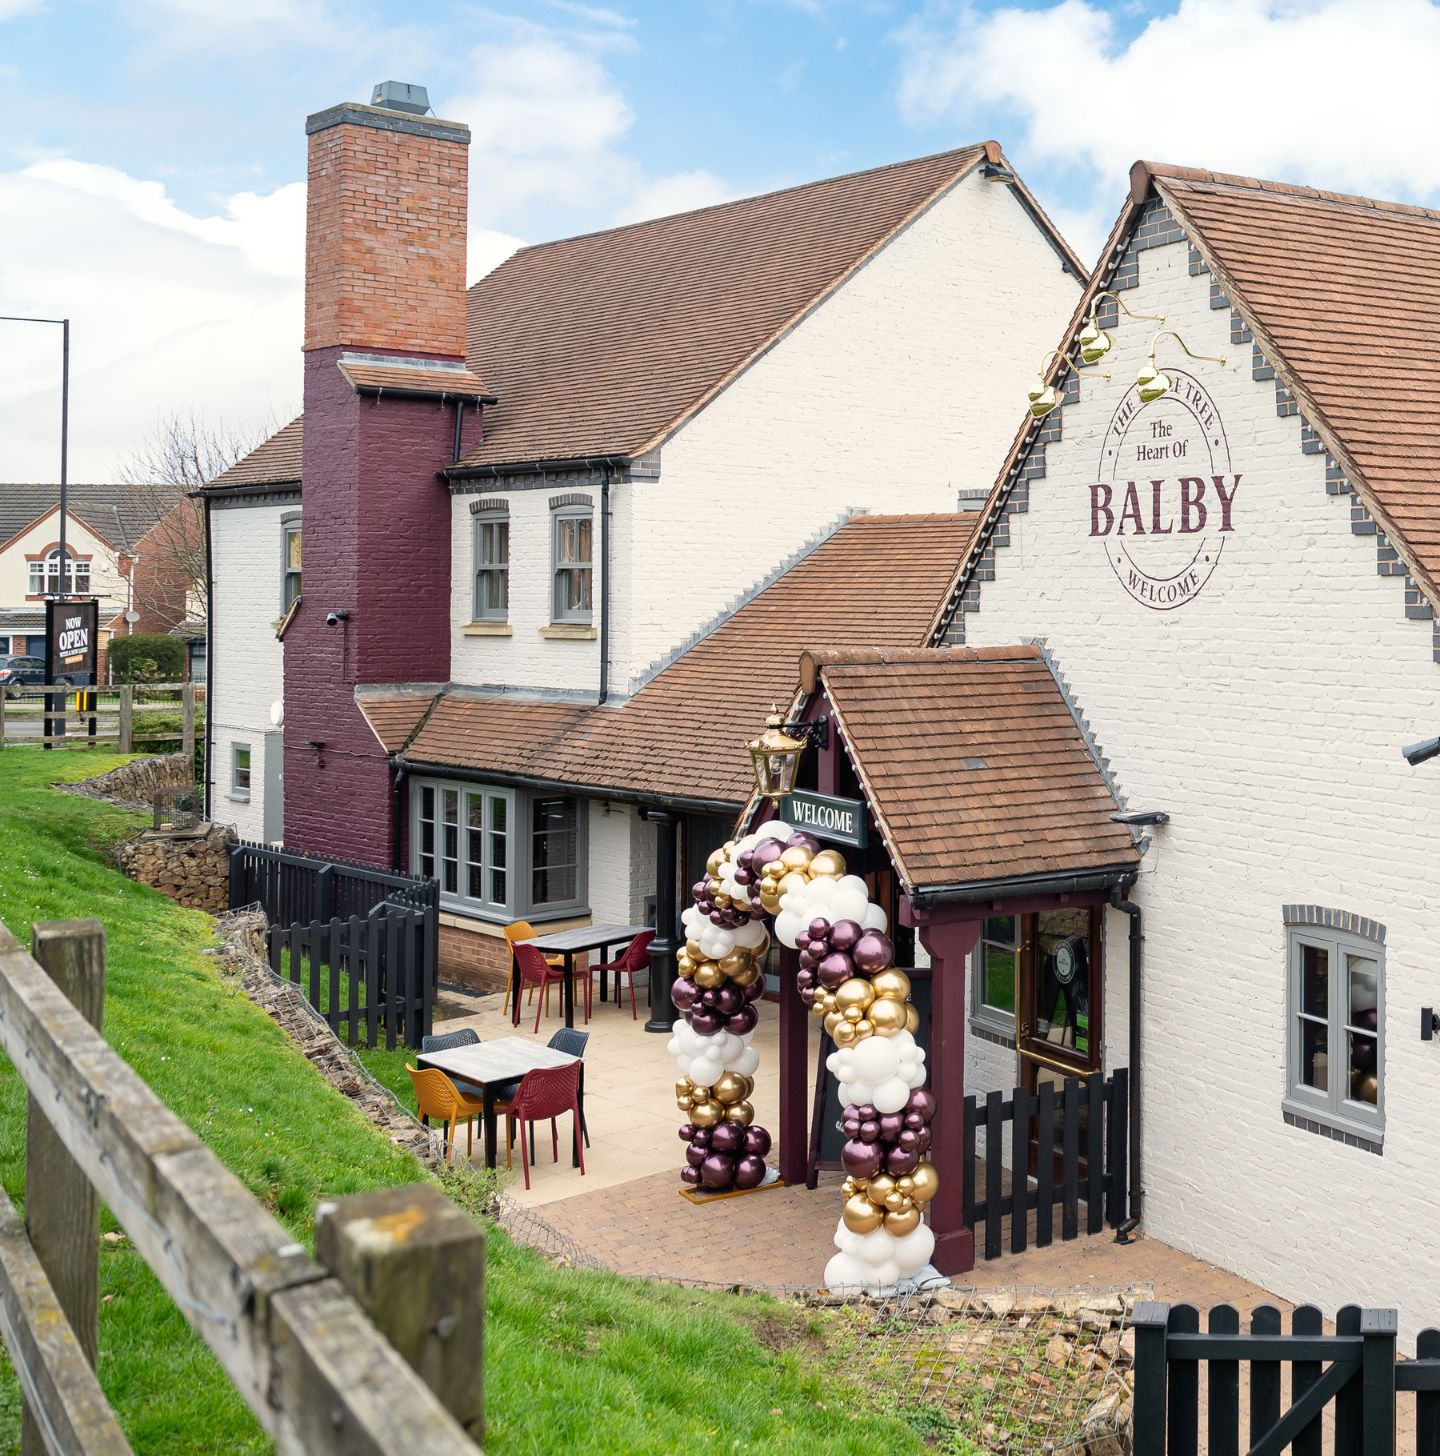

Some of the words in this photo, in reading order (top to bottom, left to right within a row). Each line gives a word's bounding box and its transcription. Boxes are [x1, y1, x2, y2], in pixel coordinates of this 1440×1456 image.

[1112, 398, 1136, 436] THE
[1185, 382, 1216, 431] TREE
[1150, 420, 1173, 439] The
[1136, 444, 1170, 461] Heart
[1173, 439, 1189, 458] Of
[1088, 474, 1243, 537] BALBY
[1128, 569, 1200, 603] WELCOME
[65, 616, 82, 630] NOW
[59, 628, 88, 651] OPEN
[792, 800, 853, 833] WELCOME
